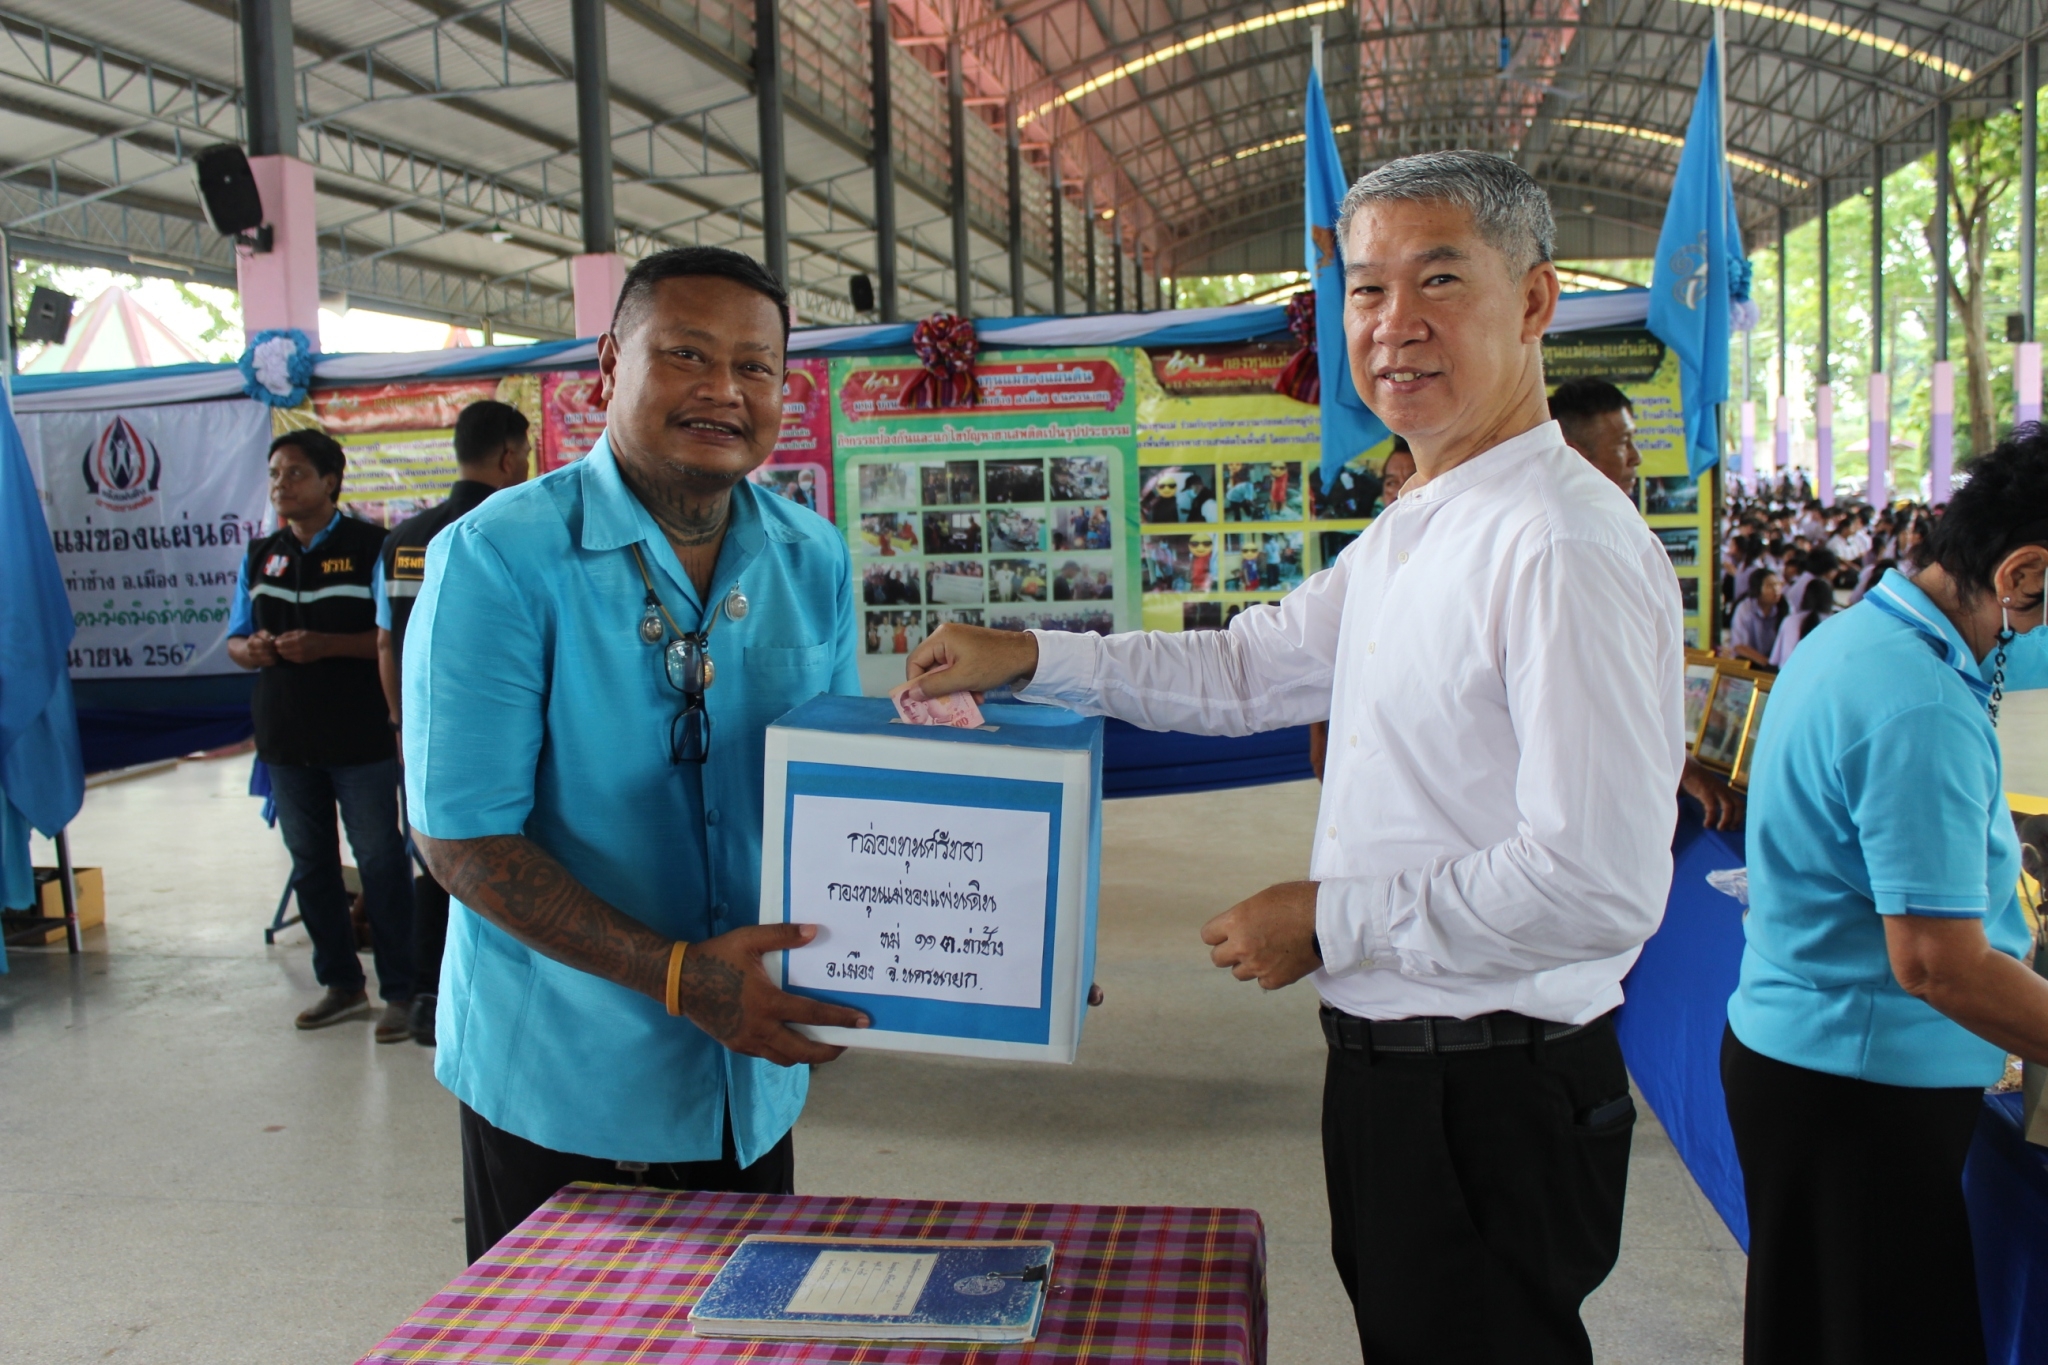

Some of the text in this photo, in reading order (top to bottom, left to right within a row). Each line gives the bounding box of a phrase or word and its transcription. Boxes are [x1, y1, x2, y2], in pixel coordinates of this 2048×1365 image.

[122, 569, 178, 590] อ.เมือง
[143, 643, 196, 667] 2567
[847, 821, 983, 874] กล่องทุนศรัทธา
[827, 879, 997, 918] กองทุนแม่ของแผ่นดิน
[826, 951, 875, 980] อ.เมือง
